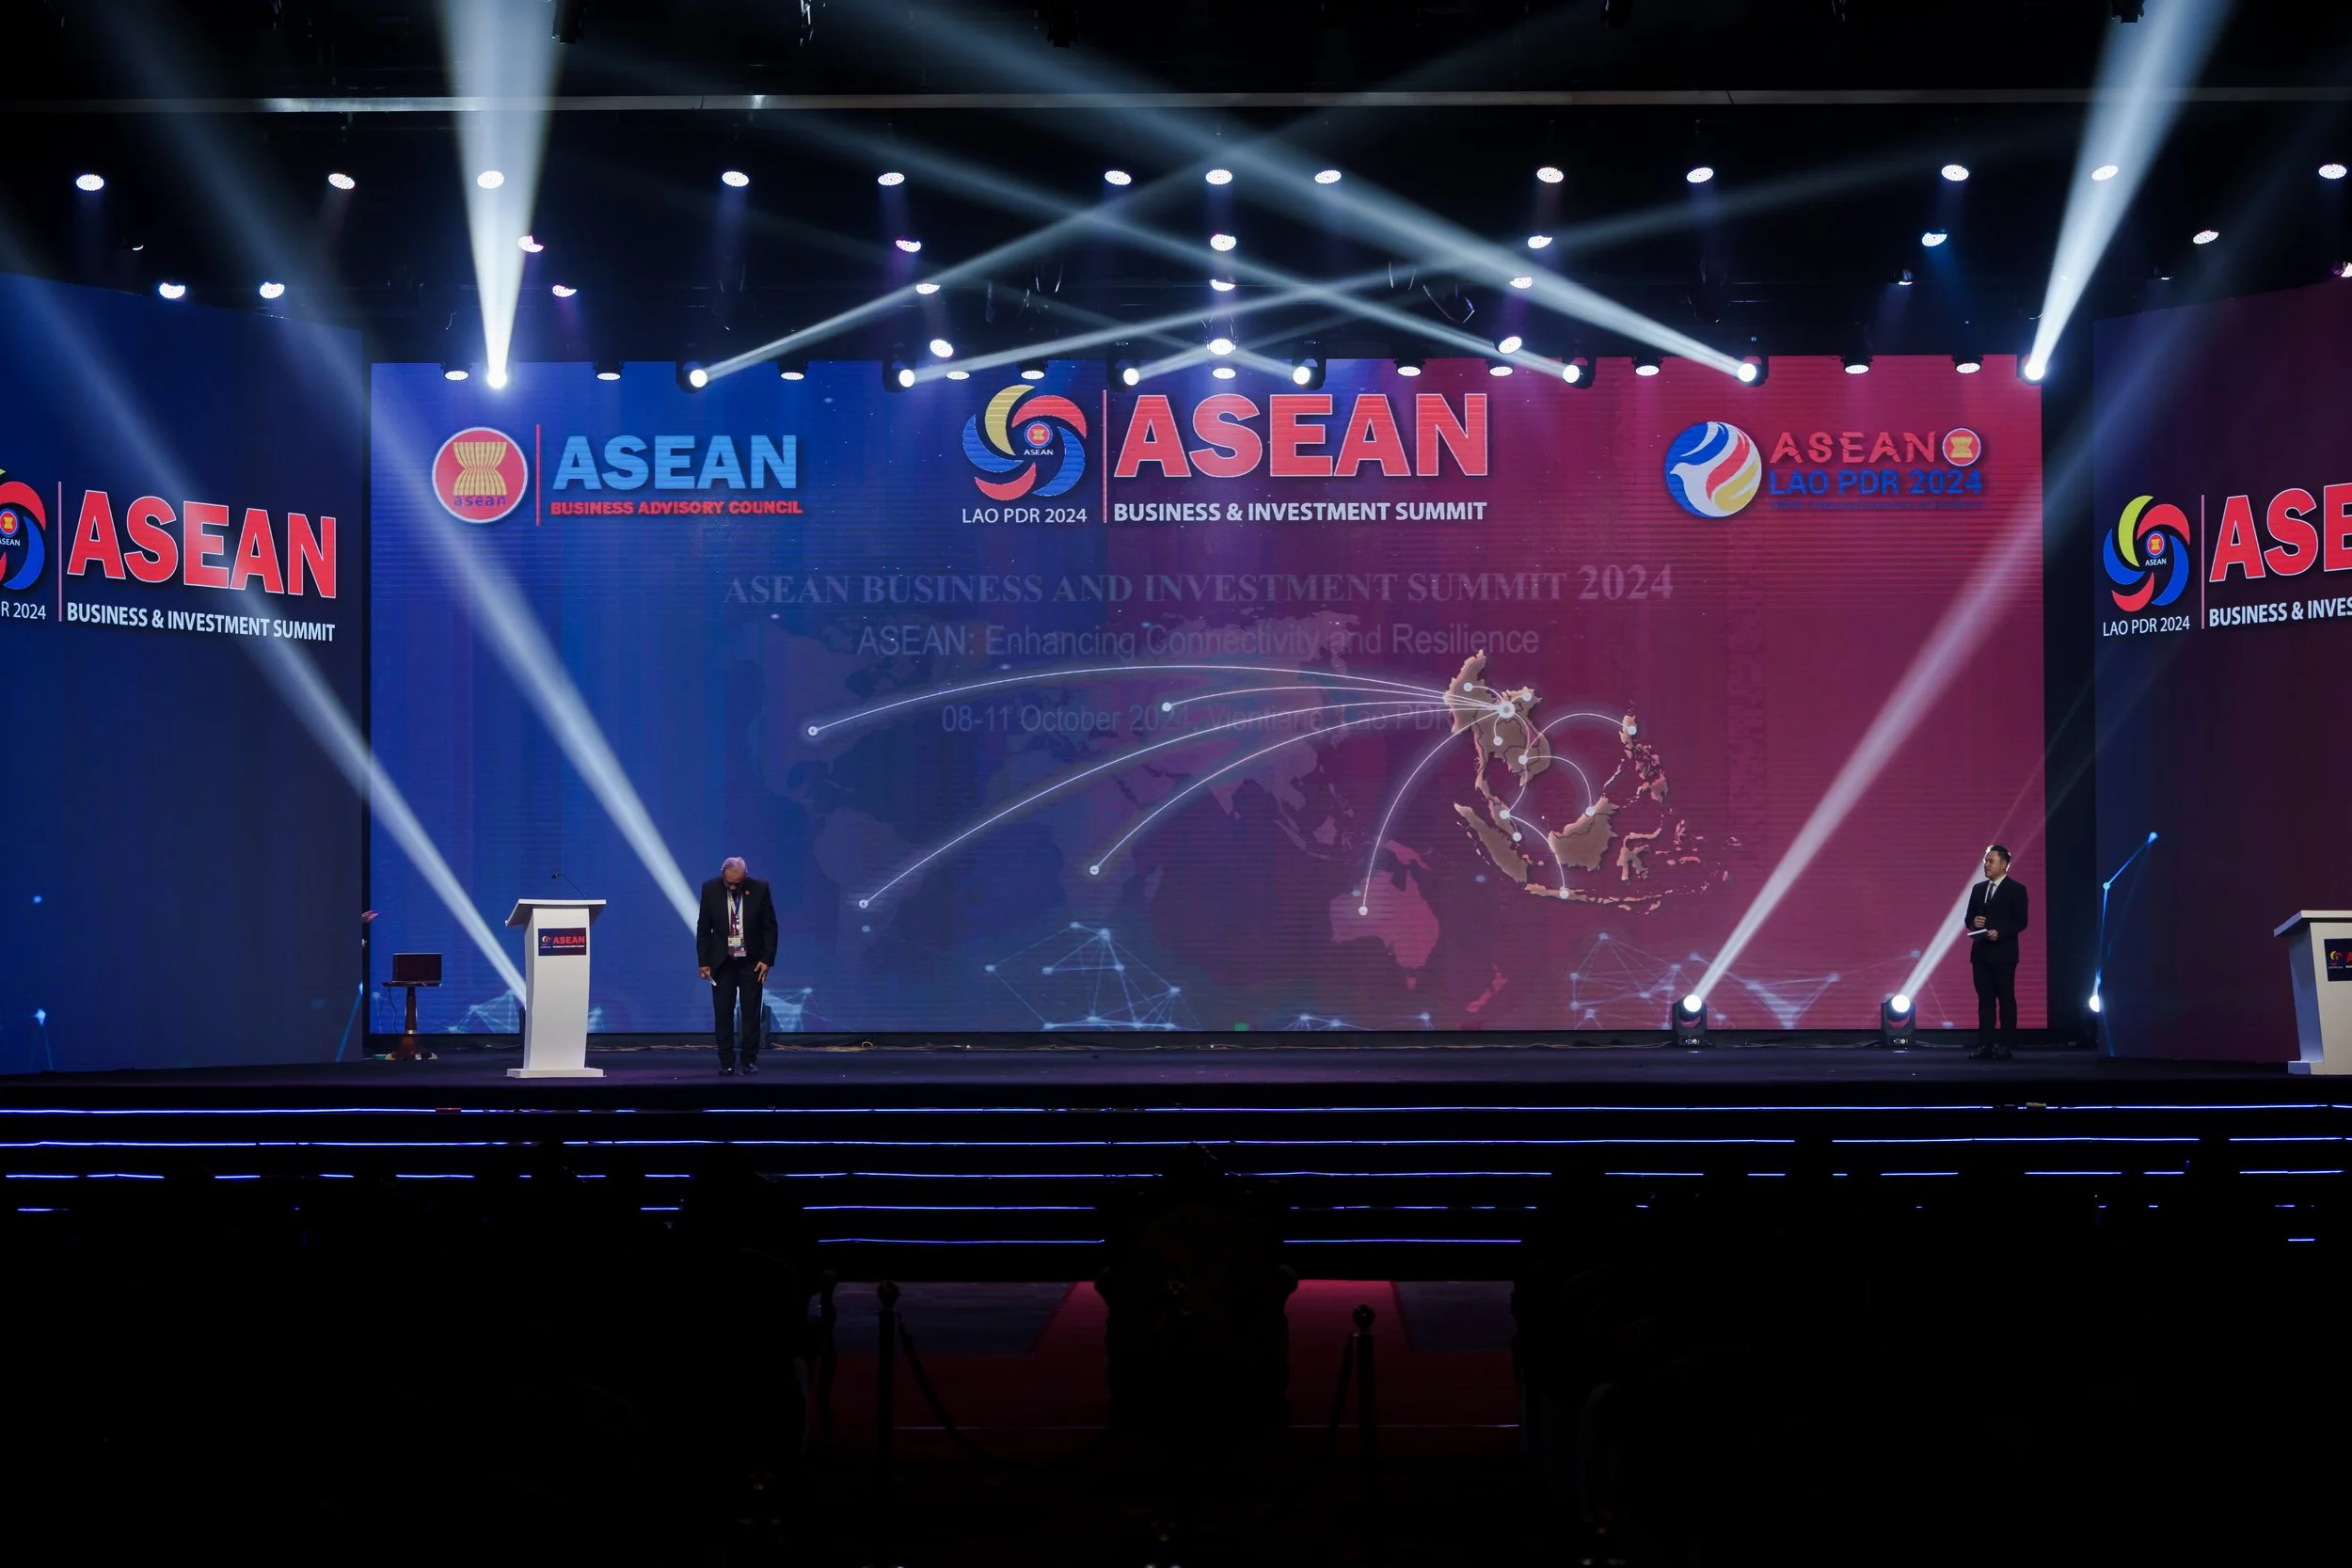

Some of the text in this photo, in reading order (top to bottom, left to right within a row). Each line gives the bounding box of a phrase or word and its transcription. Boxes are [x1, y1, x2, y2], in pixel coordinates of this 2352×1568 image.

[1114, 393, 1487, 478] ASEAN
[1770, 431, 1936, 464] ASEAN
[552, 435, 797, 490] ASEAN
[1770, 468, 1982, 495] LAO PDR 2024
[453, 495, 508, 507] asean
[550, 500, 803, 515] BUSINESS ADVISORY COUNCIL
[1114, 501, 1487, 522] BUSINESS & INVESTMENT SUMMIT
[962, 507, 1087, 524] LAO PDR 2024
[67, 489, 336, 598] ASEAN
[2145, 558, 2167, 566] ASEAN
[723, 564, 1675, 604] ASEAN BUSINESS AND INVESTMENT SUMMIT 2024
[13, 602, 47, 620] 2024
[67, 602, 335, 641] BUSINESS & INVESTMENT SUMMIT
[2209, 602, 2287, 626] BUSINESS
[2291, 601, 2304, 621] &
[2103, 615, 2190, 637] LAO PDR 2024
[856, 623, 1539, 661] ASEAN: Enhancing Connectivity and Resilience
[942, 705, 1009, 733] 08-11
[1021, 705, 1123, 733] October
[553, 936, 585, 944] ASEAN
